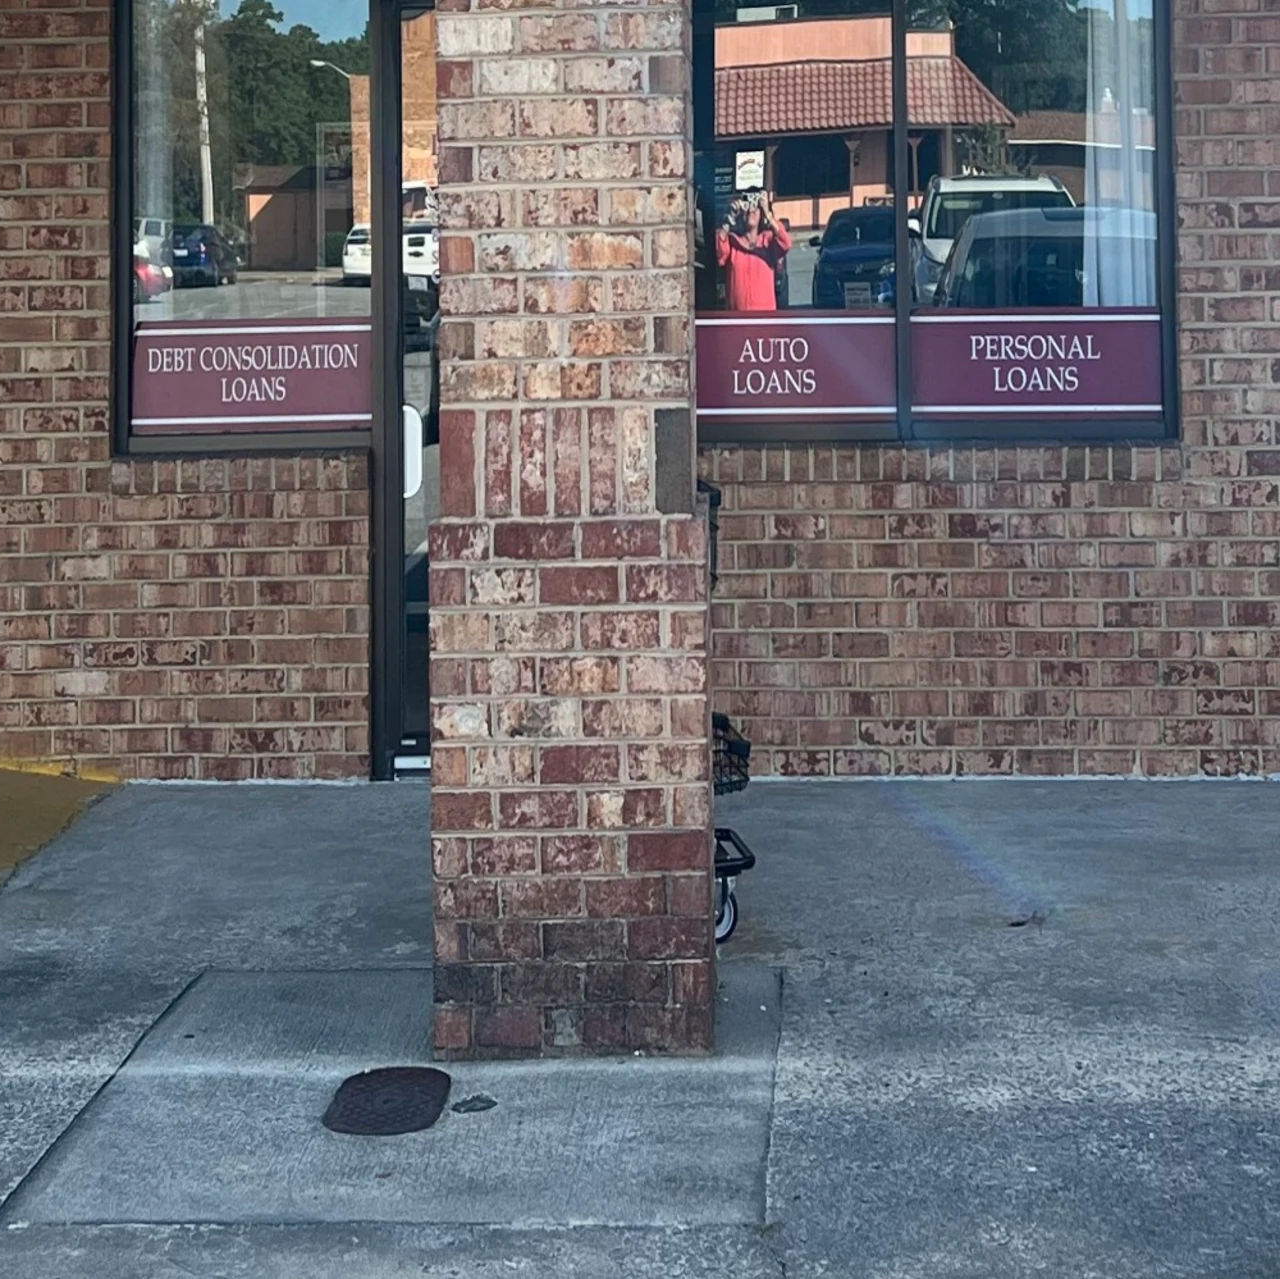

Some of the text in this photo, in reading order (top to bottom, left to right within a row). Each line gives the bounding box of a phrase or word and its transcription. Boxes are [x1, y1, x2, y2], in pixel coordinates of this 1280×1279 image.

[147, 343, 359, 373] DEBT CONSOLIDATION
[738, 337, 809, 363] AUTO
[970, 334, 1101, 361] PERSONAL
[220, 376, 287, 403] LOANS
[732, 368, 817, 394] LOANS
[993, 366, 1079, 392] LOANS
